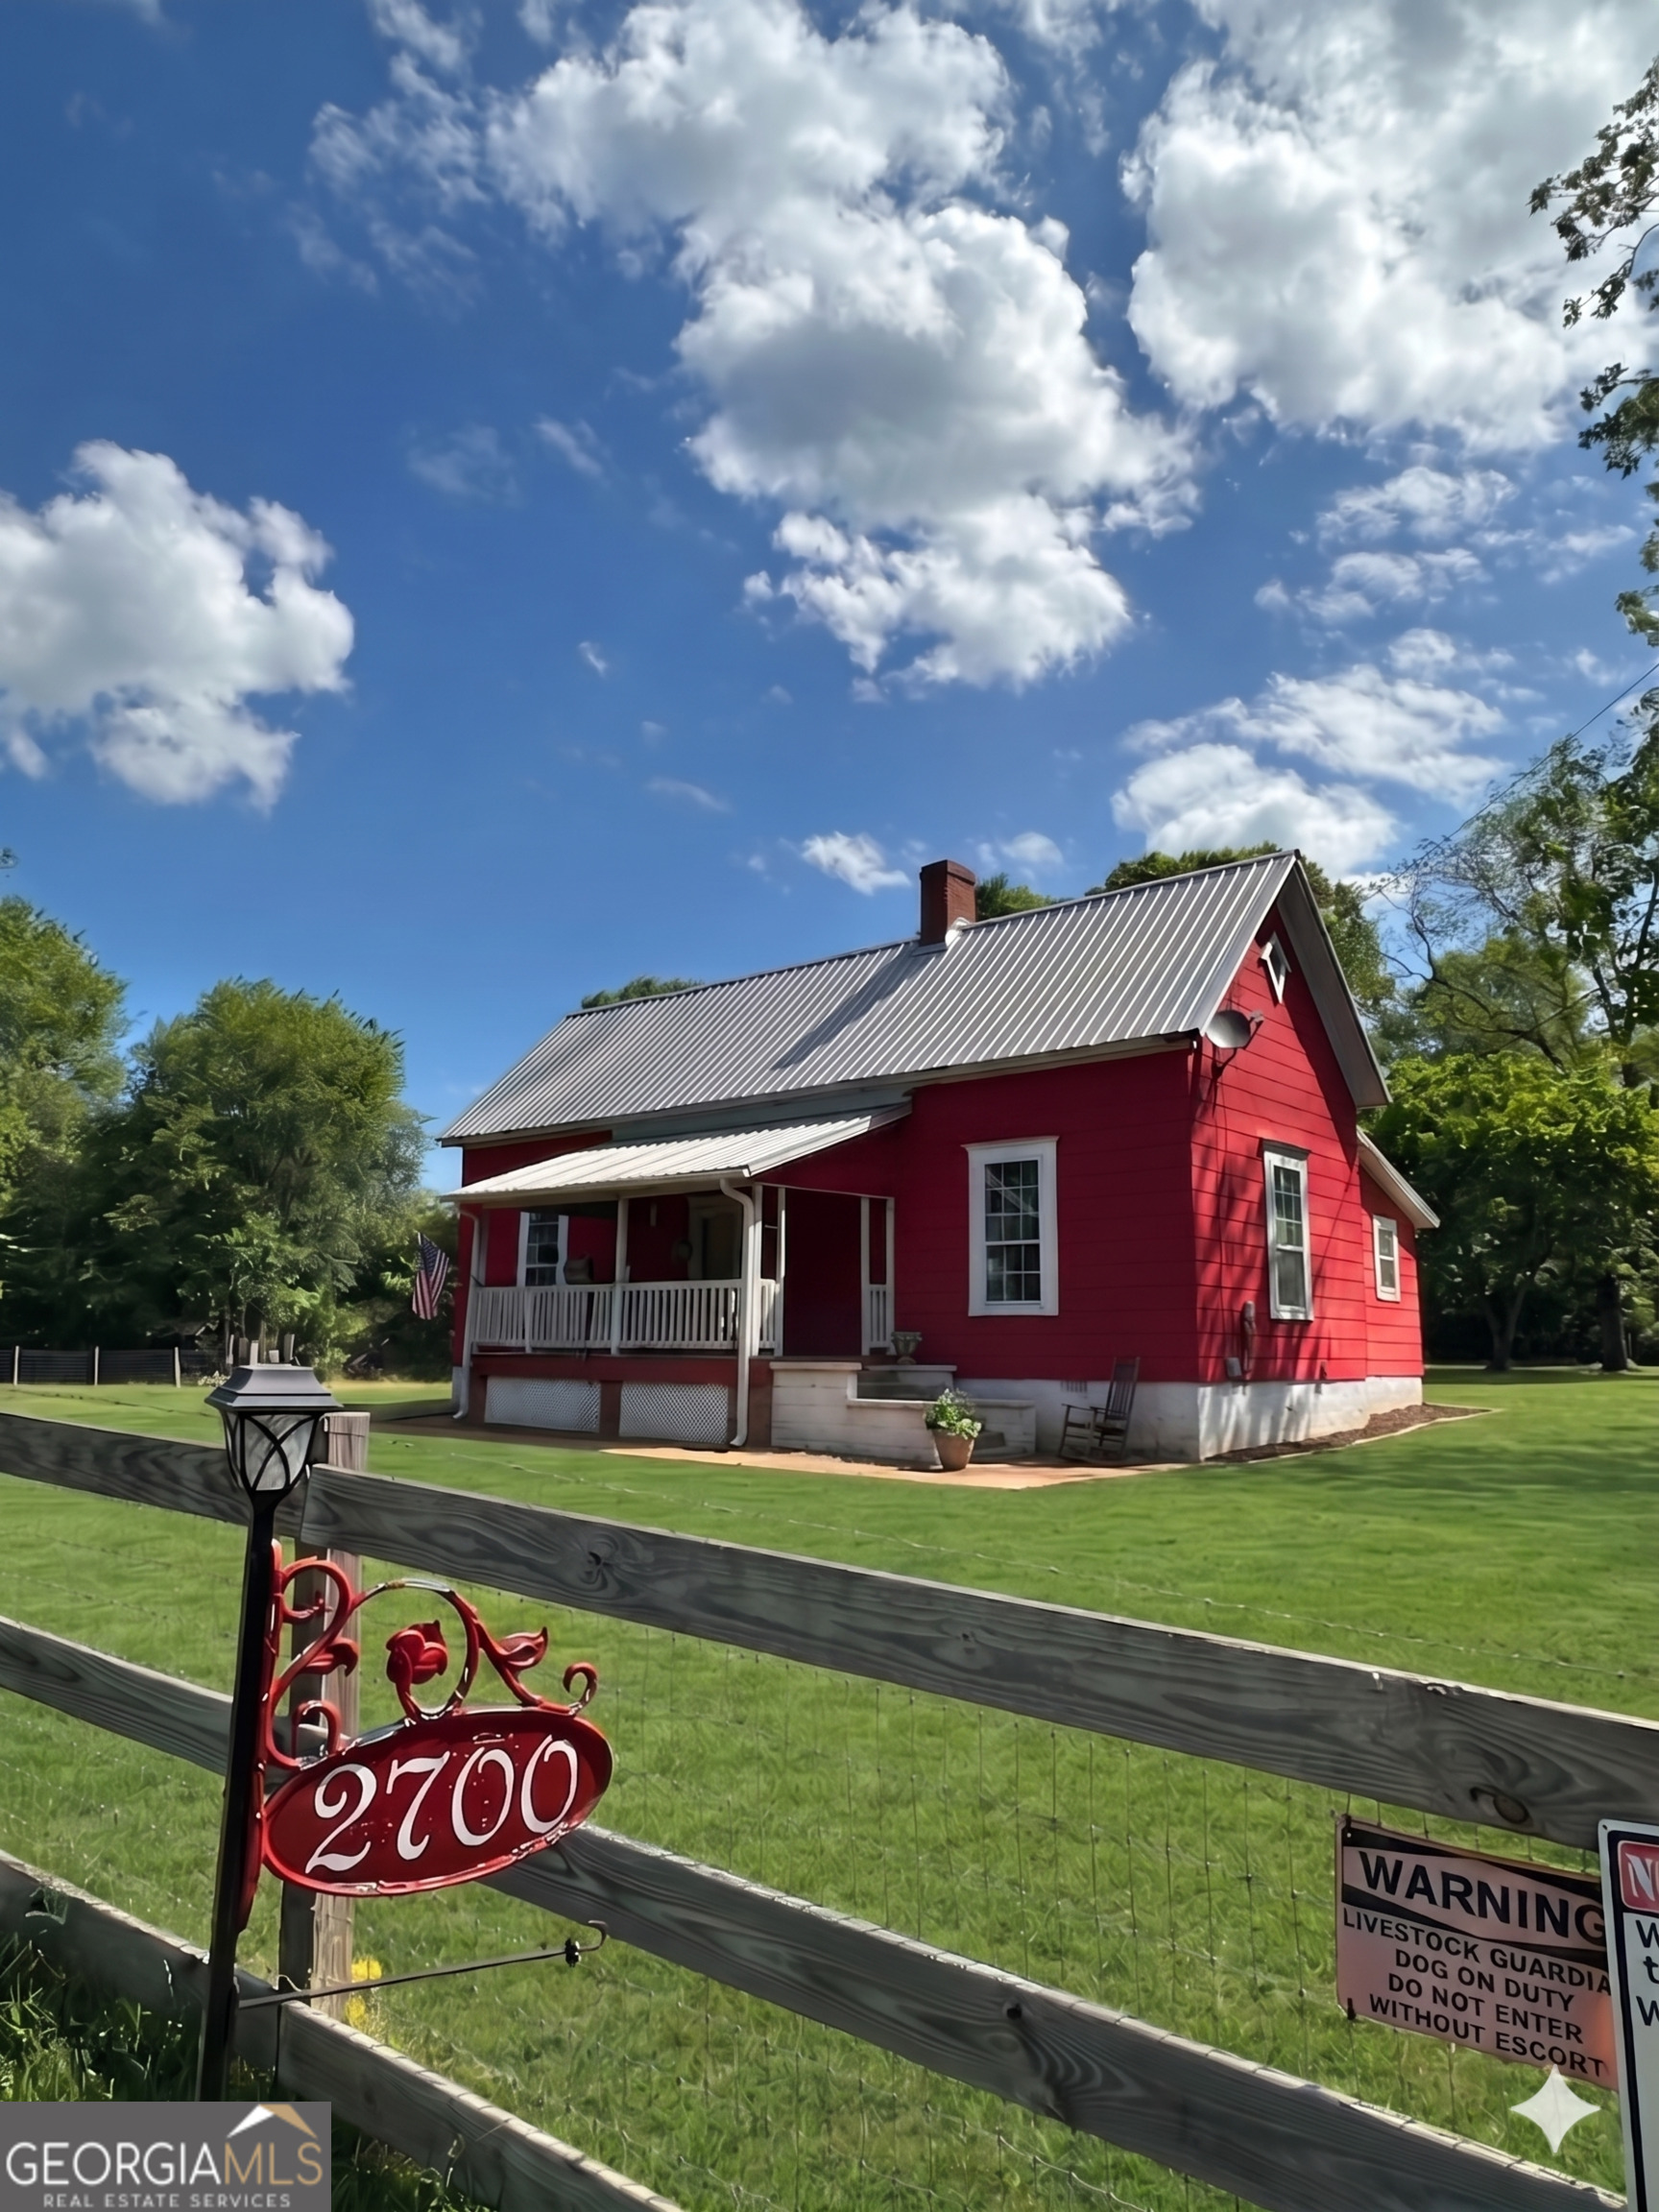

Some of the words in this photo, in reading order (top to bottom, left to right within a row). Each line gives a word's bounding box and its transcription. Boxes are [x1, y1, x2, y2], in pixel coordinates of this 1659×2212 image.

[304, 1734, 579, 1874] 2700
[1358, 1850, 1606, 1948] WARNING
[1624, 1852, 1659, 1903] N
[1343, 1907, 1480, 1964] LIVESTOCK
[1388, 1972, 1423, 1999] DO
[1431, 1984, 1485, 2017] NOT
[1495, 2003, 1584, 2045] ENTER
[1395, 1948, 1449, 1980] DOG
[1457, 1965, 1496, 1994] ON
[1504, 1977, 1575, 2012] DUTY
[1369, 1993, 1486, 2044] WITHOUT
[1495, 2031, 1607, 2078] ESCORT
